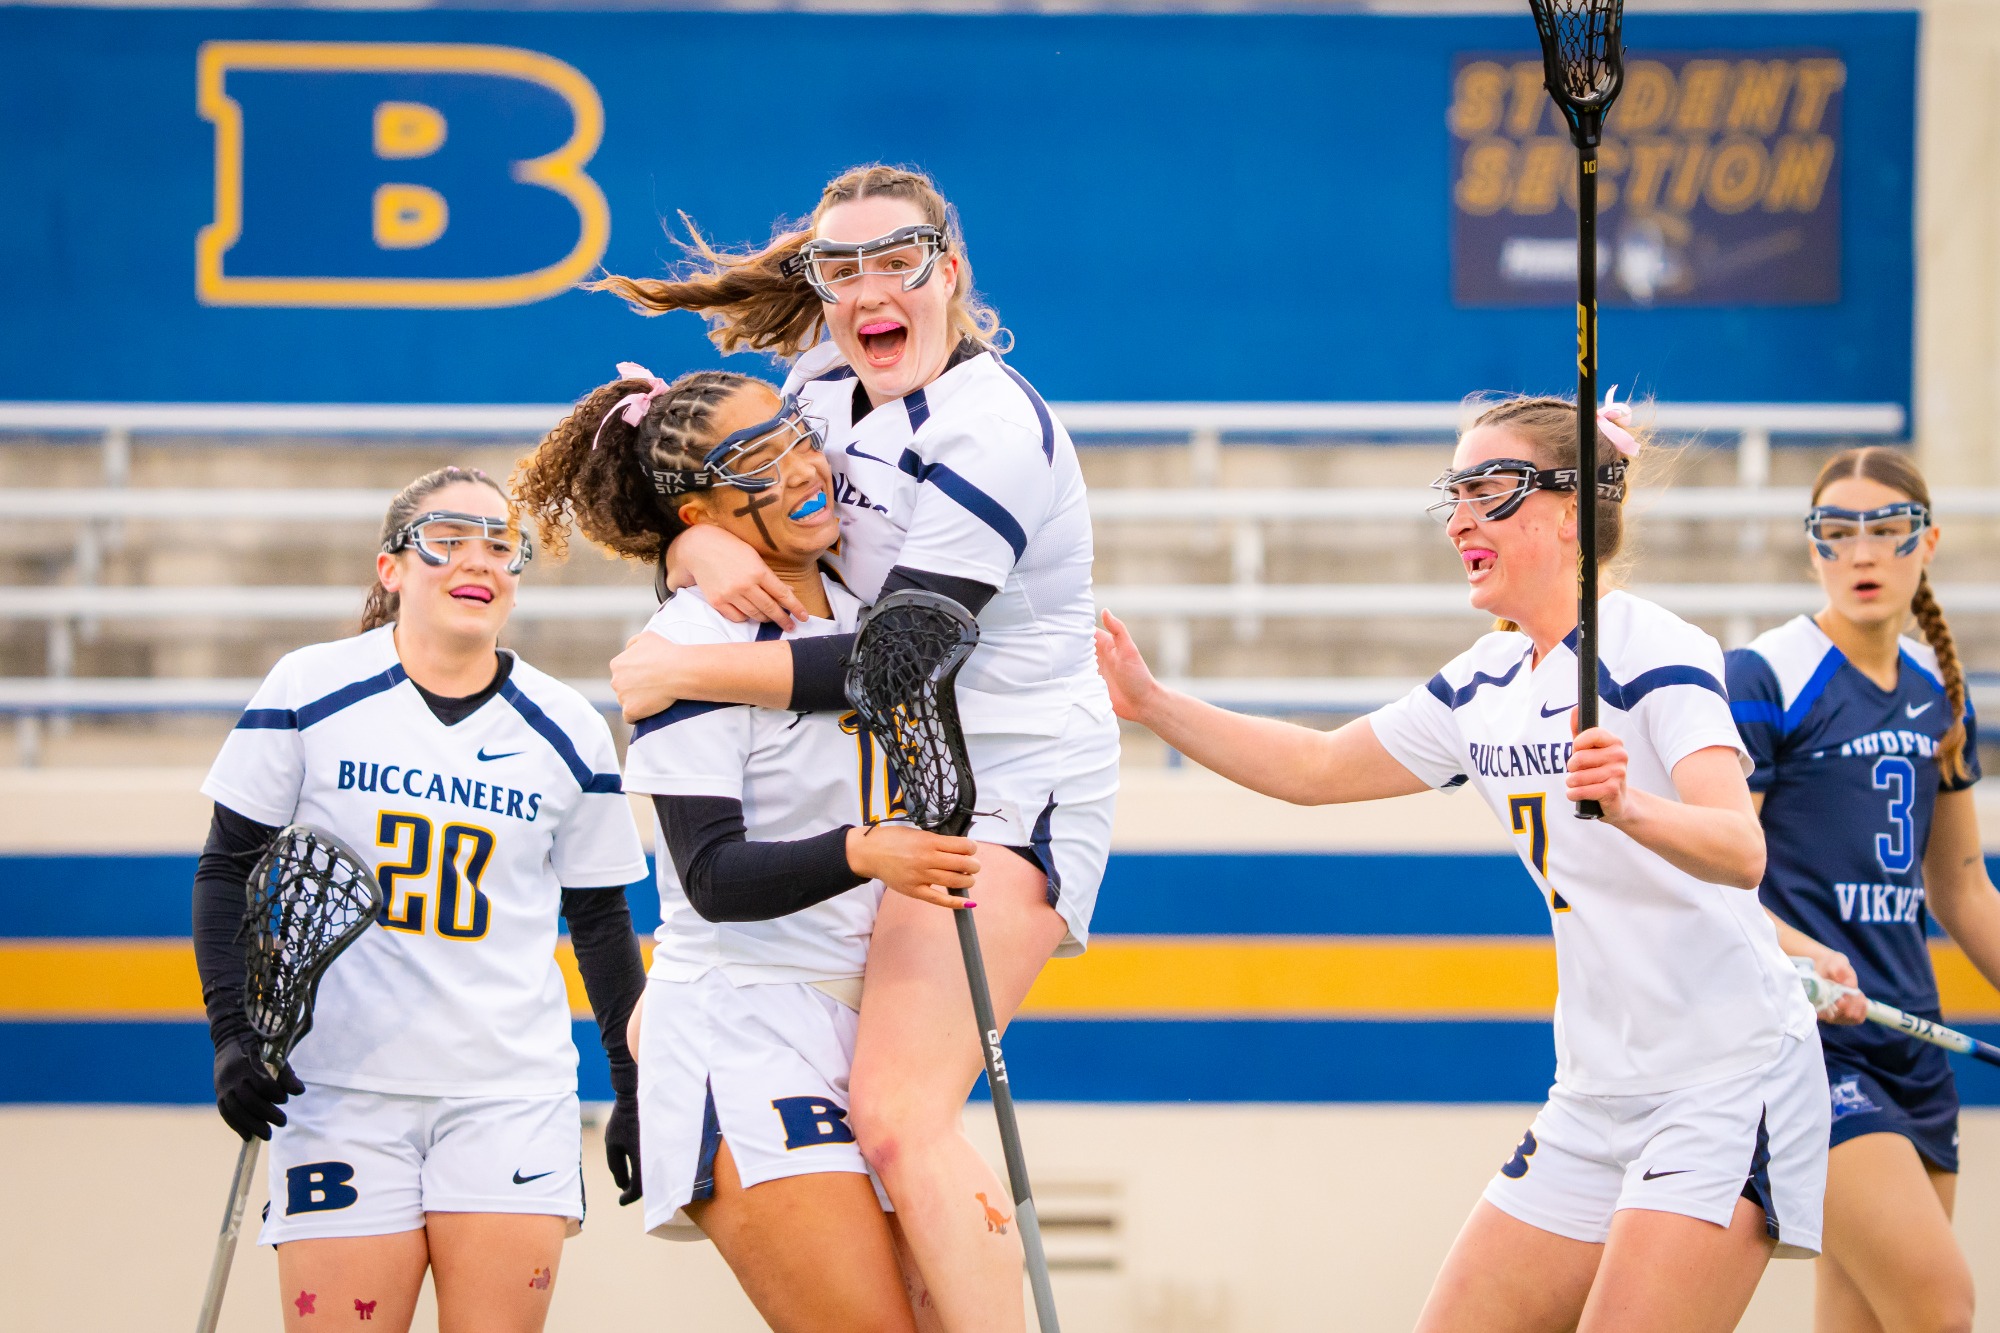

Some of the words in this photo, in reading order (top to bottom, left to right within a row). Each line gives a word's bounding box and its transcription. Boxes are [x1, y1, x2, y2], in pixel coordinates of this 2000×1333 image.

[1448, 60, 1845, 138] STDENT
[196, 40, 611, 308] B
[652, 470, 686, 485] STX
[337, 760, 542, 822] BUCCANEERS
[1872, 755, 1915, 875] 3
[375, 809, 496, 942] 20
[1507, 792, 1571, 913] 7
[987, 1029, 1009, 1084] GAIT
[771, 1095, 857, 1151] B
[285, 1161, 358, 1216] B
